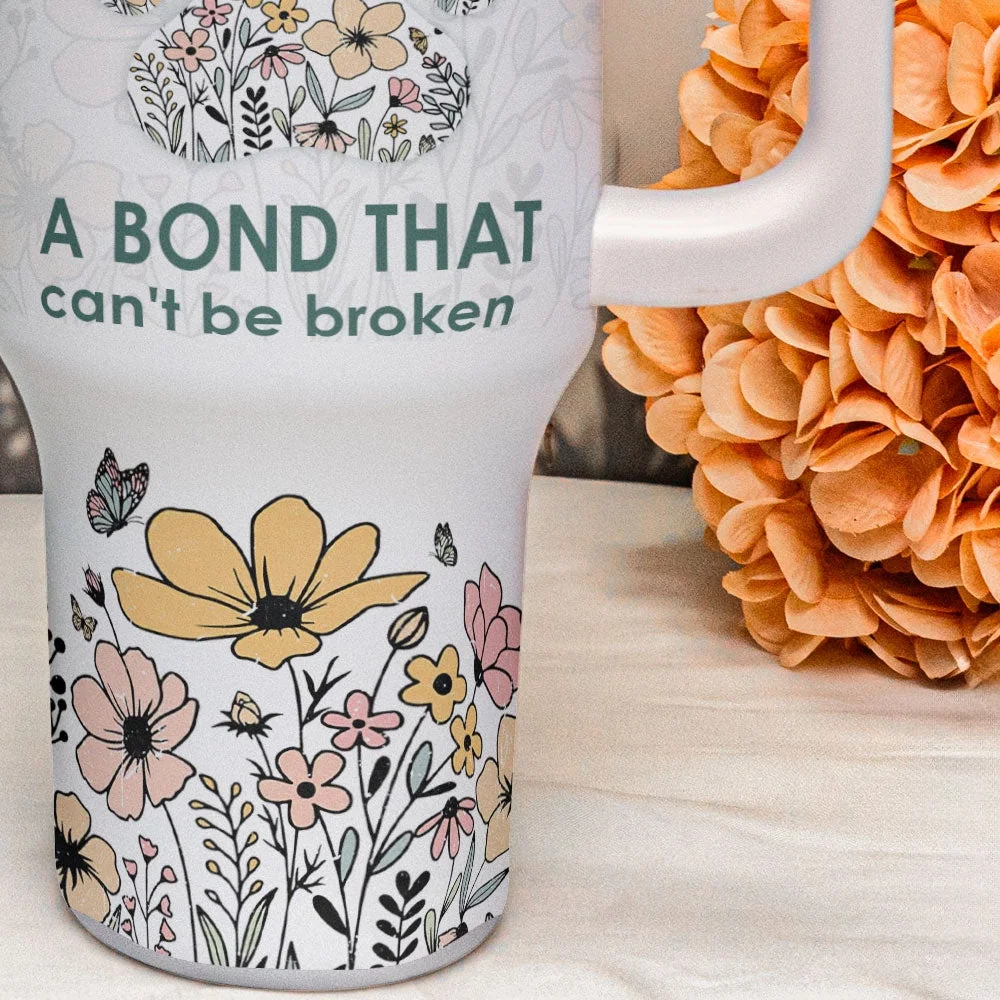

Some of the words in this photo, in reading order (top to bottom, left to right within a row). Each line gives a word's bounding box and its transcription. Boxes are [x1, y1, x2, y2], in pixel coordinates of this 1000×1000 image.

[40, 198, 83, 258] A
[113, 202, 338, 273] BOND
[365, 200, 543, 271] THAT
[40, 285, 180, 331] can't
[202, 292, 282, 337] be
[306, 292, 514, 337] broken
